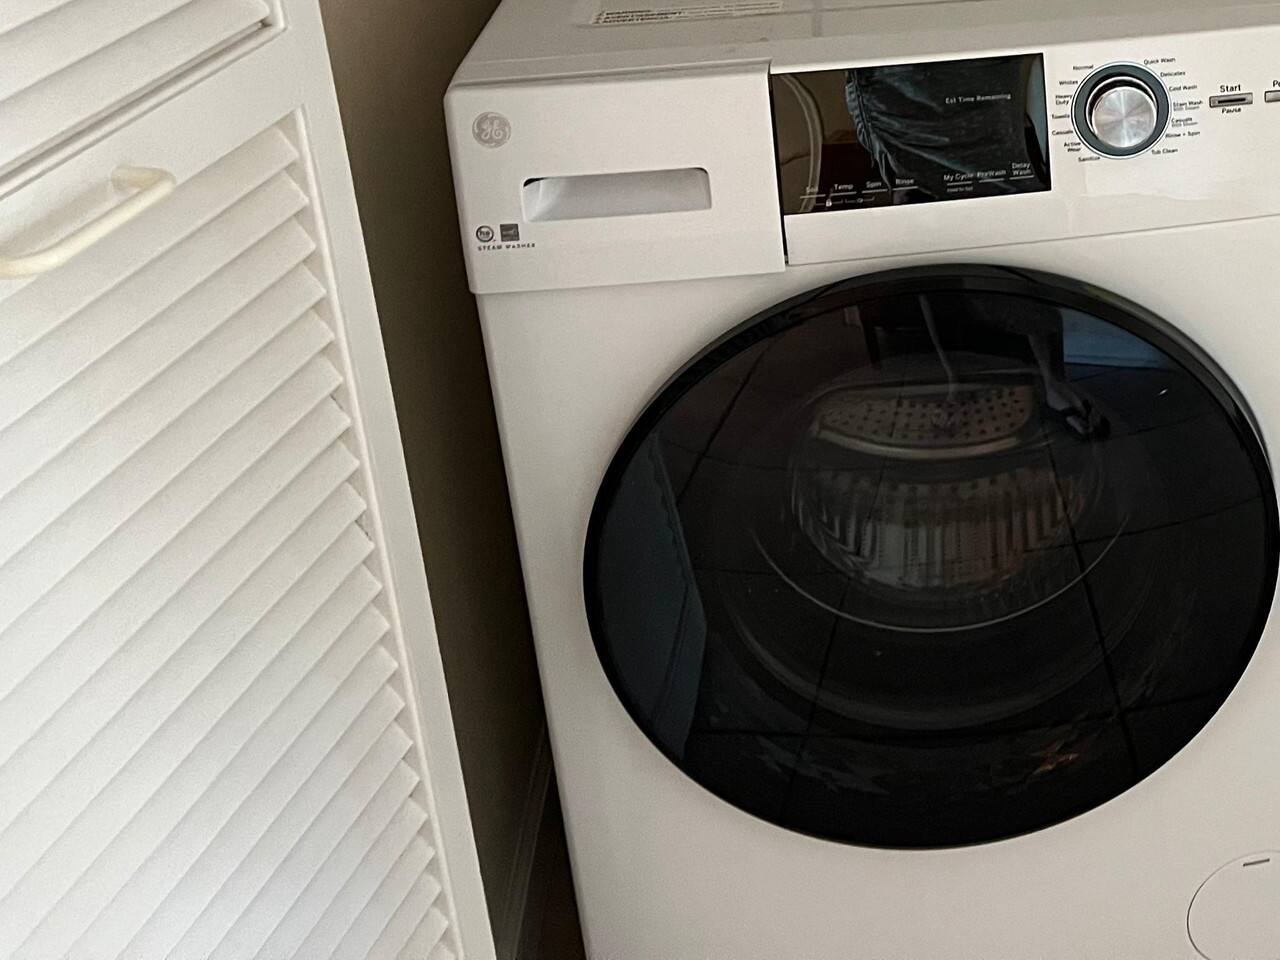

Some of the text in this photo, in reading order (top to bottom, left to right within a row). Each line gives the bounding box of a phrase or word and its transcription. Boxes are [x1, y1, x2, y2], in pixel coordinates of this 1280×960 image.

[1219, 84, 1242, 94] Start
[1221, 107, 1242, 115] Pause
[943, 173, 955, 184] My
[834, 183, 855, 192] Temp
[477, 244, 503, 252] STEAM
